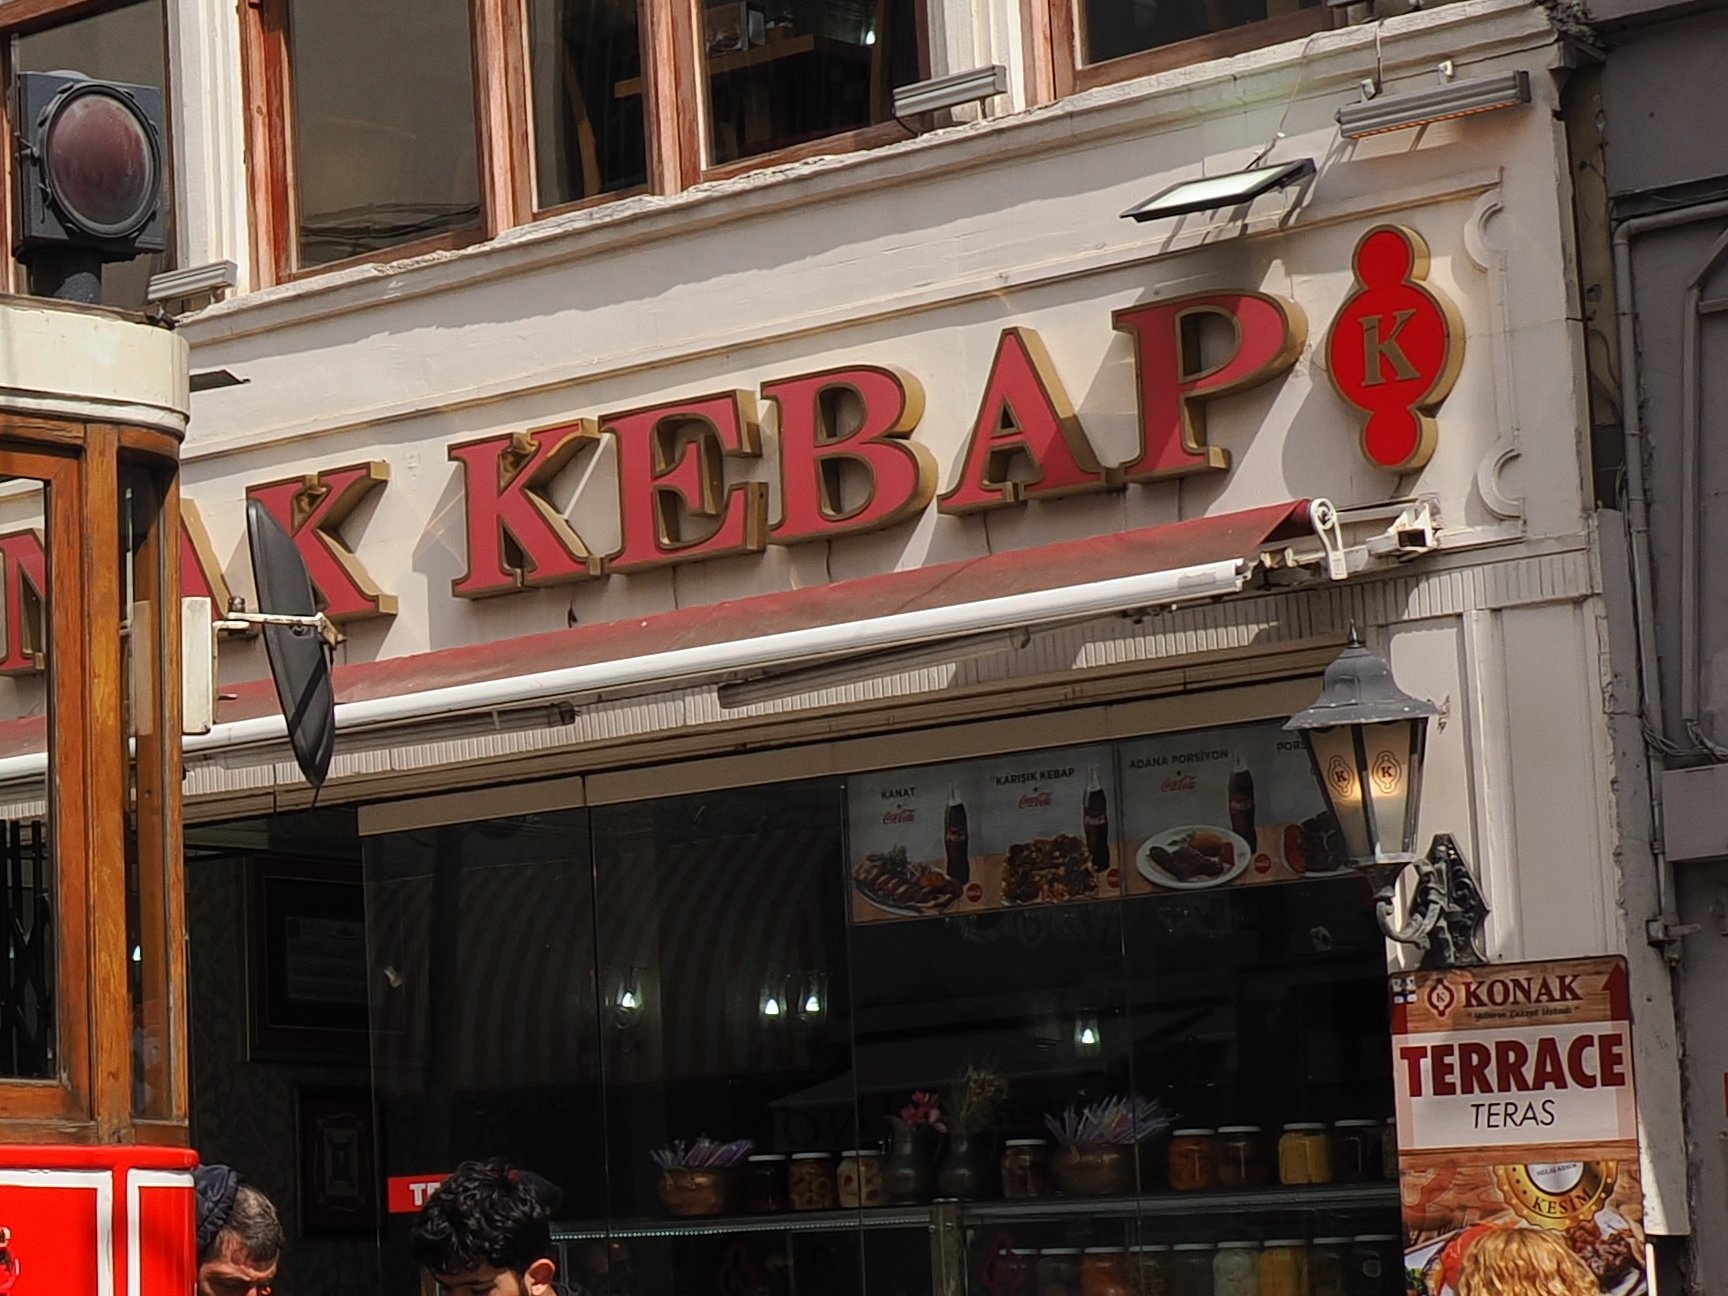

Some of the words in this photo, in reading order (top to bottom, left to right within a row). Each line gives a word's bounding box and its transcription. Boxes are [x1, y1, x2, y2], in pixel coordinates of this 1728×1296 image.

[1358, 307, 1422, 389] K
[446, 288, 1308, 601] KEBAP
[1040, 767, 1076, 781] KEBAP
[1462, 974, 1584, 1009] KONAK
[1400, 1033, 1626, 1098] TERRACE
[1470, 1099, 1556, 1129] TERAS
